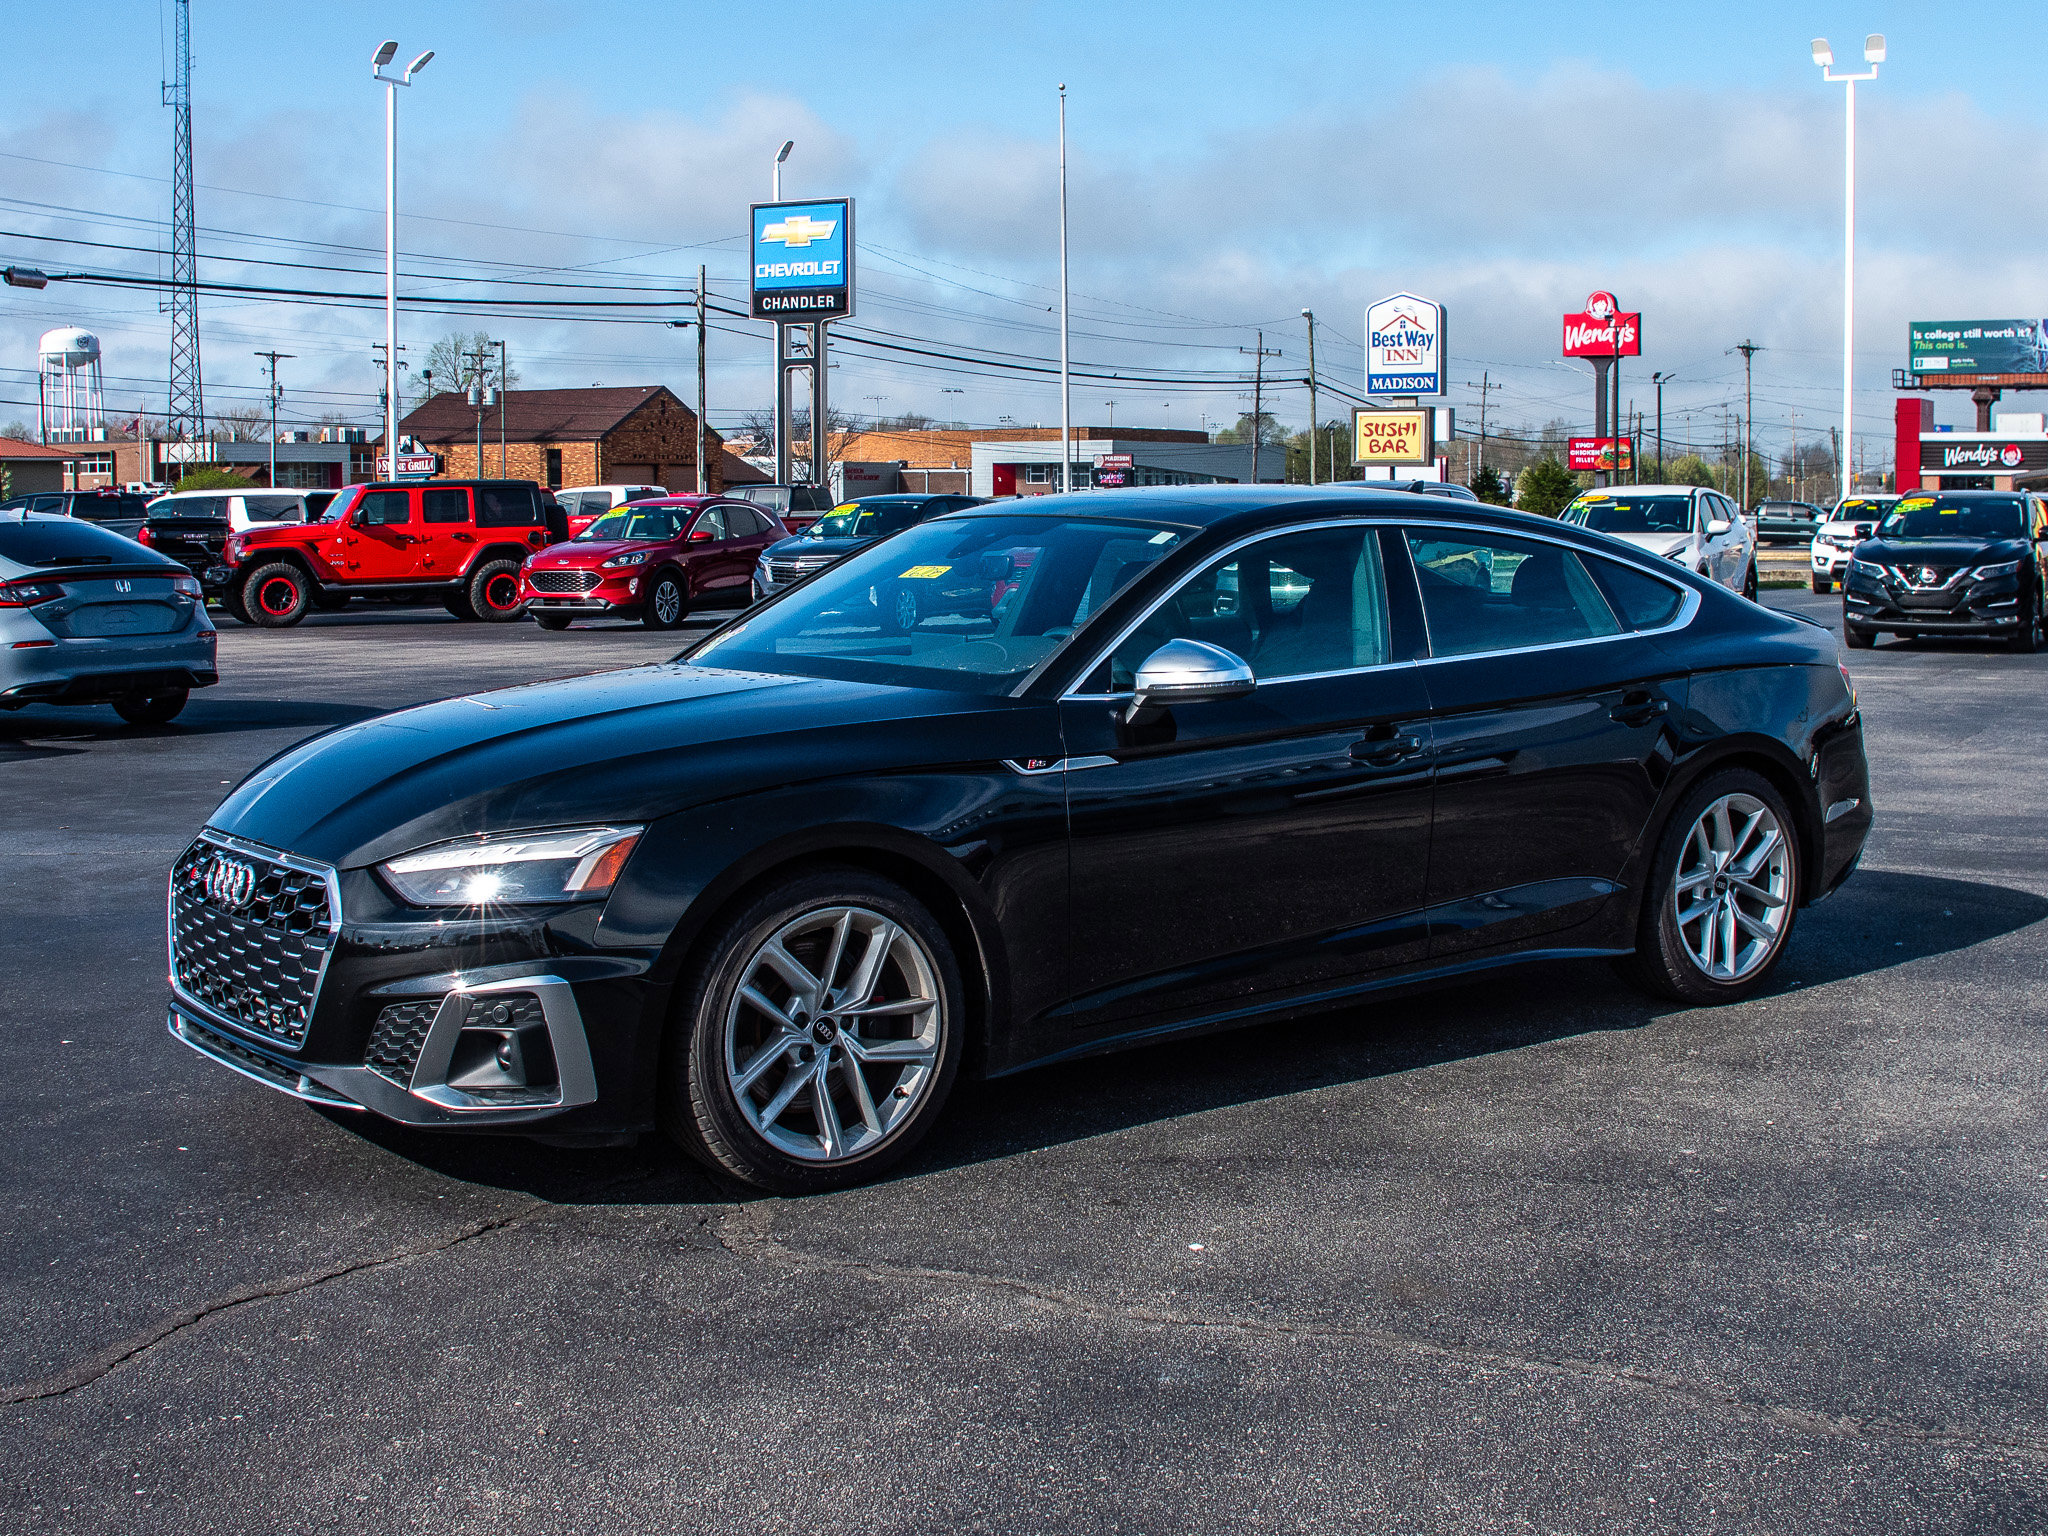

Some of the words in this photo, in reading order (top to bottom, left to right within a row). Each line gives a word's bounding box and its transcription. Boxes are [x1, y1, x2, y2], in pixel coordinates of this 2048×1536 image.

[755, 260, 841, 278] CHEVROLET
[762, 295, 835, 310] CHANDLER
[1371, 331, 1403, 348] Best
[1405, 330, 1435, 351] Way
[1565, 319, 1636, 351] Wendy's
[1913, 330, 1922, 339] Is
[1924, 329, 1961, 341] college
[1963, 328, 1982, 338] still
[1983, 327, 2015, 338] worth
[2017, 327, 2032, 337] it?
[1914, 341, 1933, 350] This
[1956, 340, 1968, 349] is.
[1385, 349, 1419, 362] INN
[1371, 377, 1435, 390] MADISON
[1363, 422, 1417, 437] SUSHI
[1369, 439, 1409, 454] BAR
[1944, 443, 1999, 467] Wendy's
[407, 459, 431, 471] GRILL
